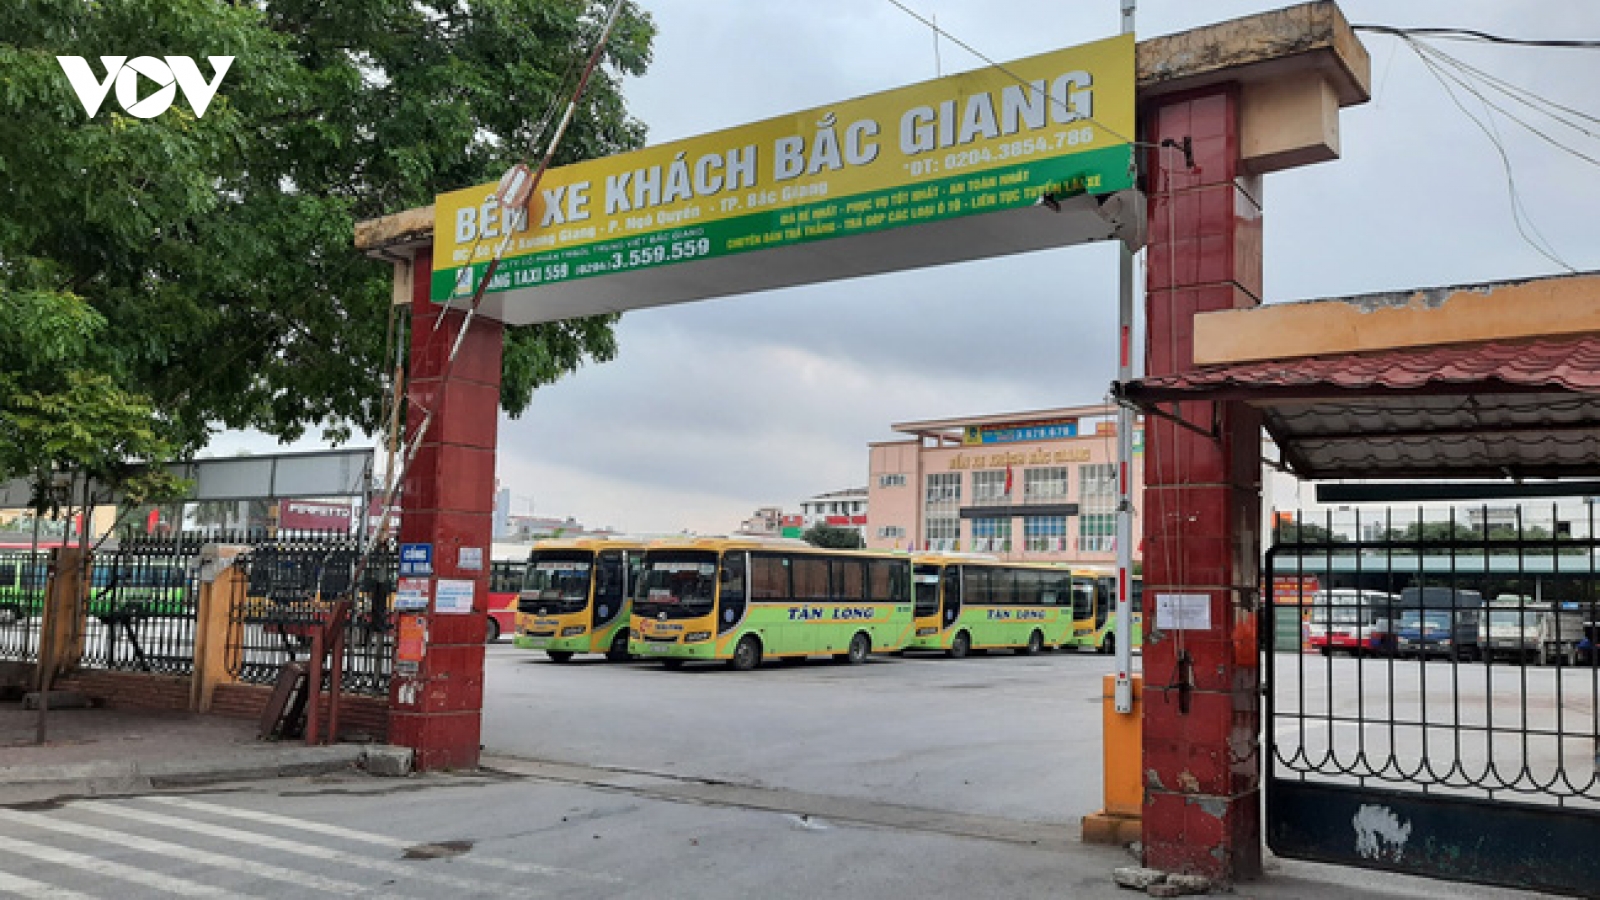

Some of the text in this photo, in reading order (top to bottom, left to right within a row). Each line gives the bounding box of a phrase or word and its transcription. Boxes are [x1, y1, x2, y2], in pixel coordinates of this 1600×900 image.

[541, 180, 592, 229] XE
[604, 148, 759, 216] KHÁCH
[774, 111, 881, 183] BẮC
[899, 69, 1094, 157] GIANG
[559, 225, 597, 242] Giang
[747, 187, 777, 209] Bắc
[782, 179, 828, 201] Giang
[514, 267, 543, 286] TAXI
[544, 261, 570, 281] 559
[787, 604, 876, 621] TÂN LONG
